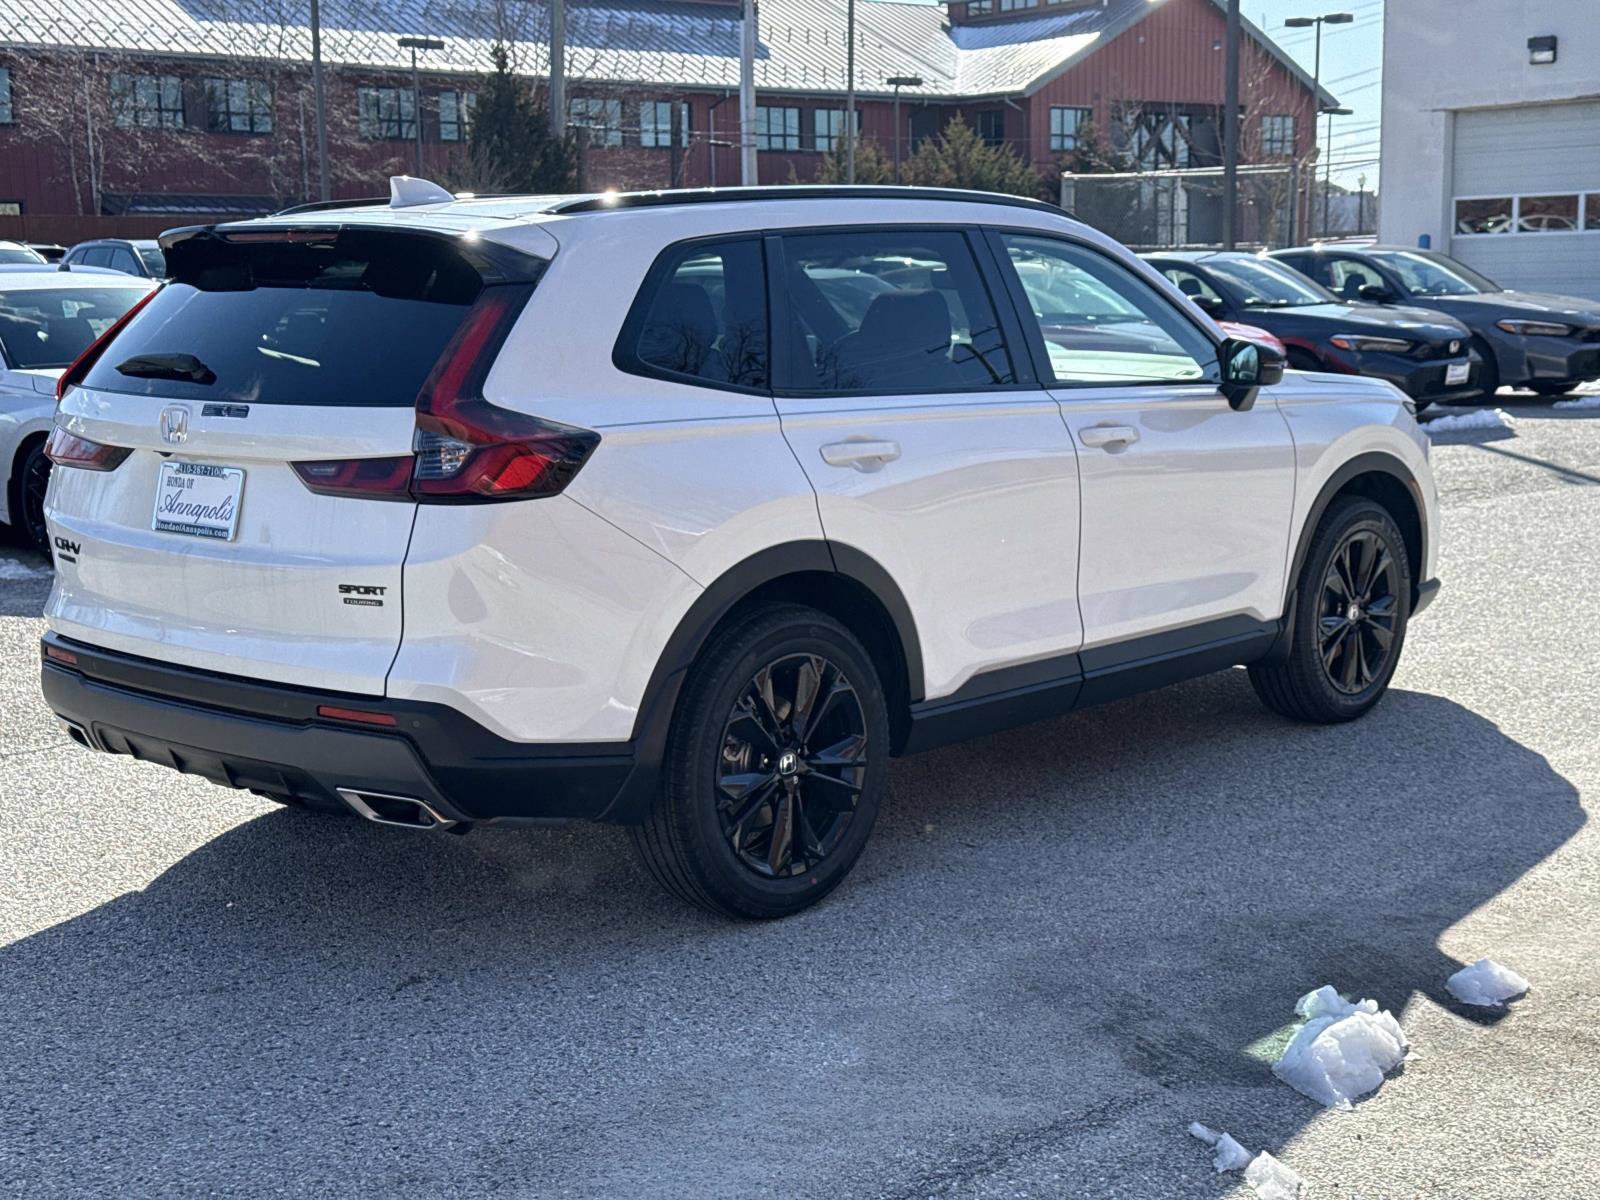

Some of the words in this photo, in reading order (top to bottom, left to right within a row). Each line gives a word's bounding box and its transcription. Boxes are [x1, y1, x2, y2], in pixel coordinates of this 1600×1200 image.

[167, 475, 185, 488] HONDA
[186, 478, 195, 489] OF
[160, 489, 235, 524] Annapolis
[55, 536, 81, 555] CR-V
[338, 584, 388, 596] SPORT
